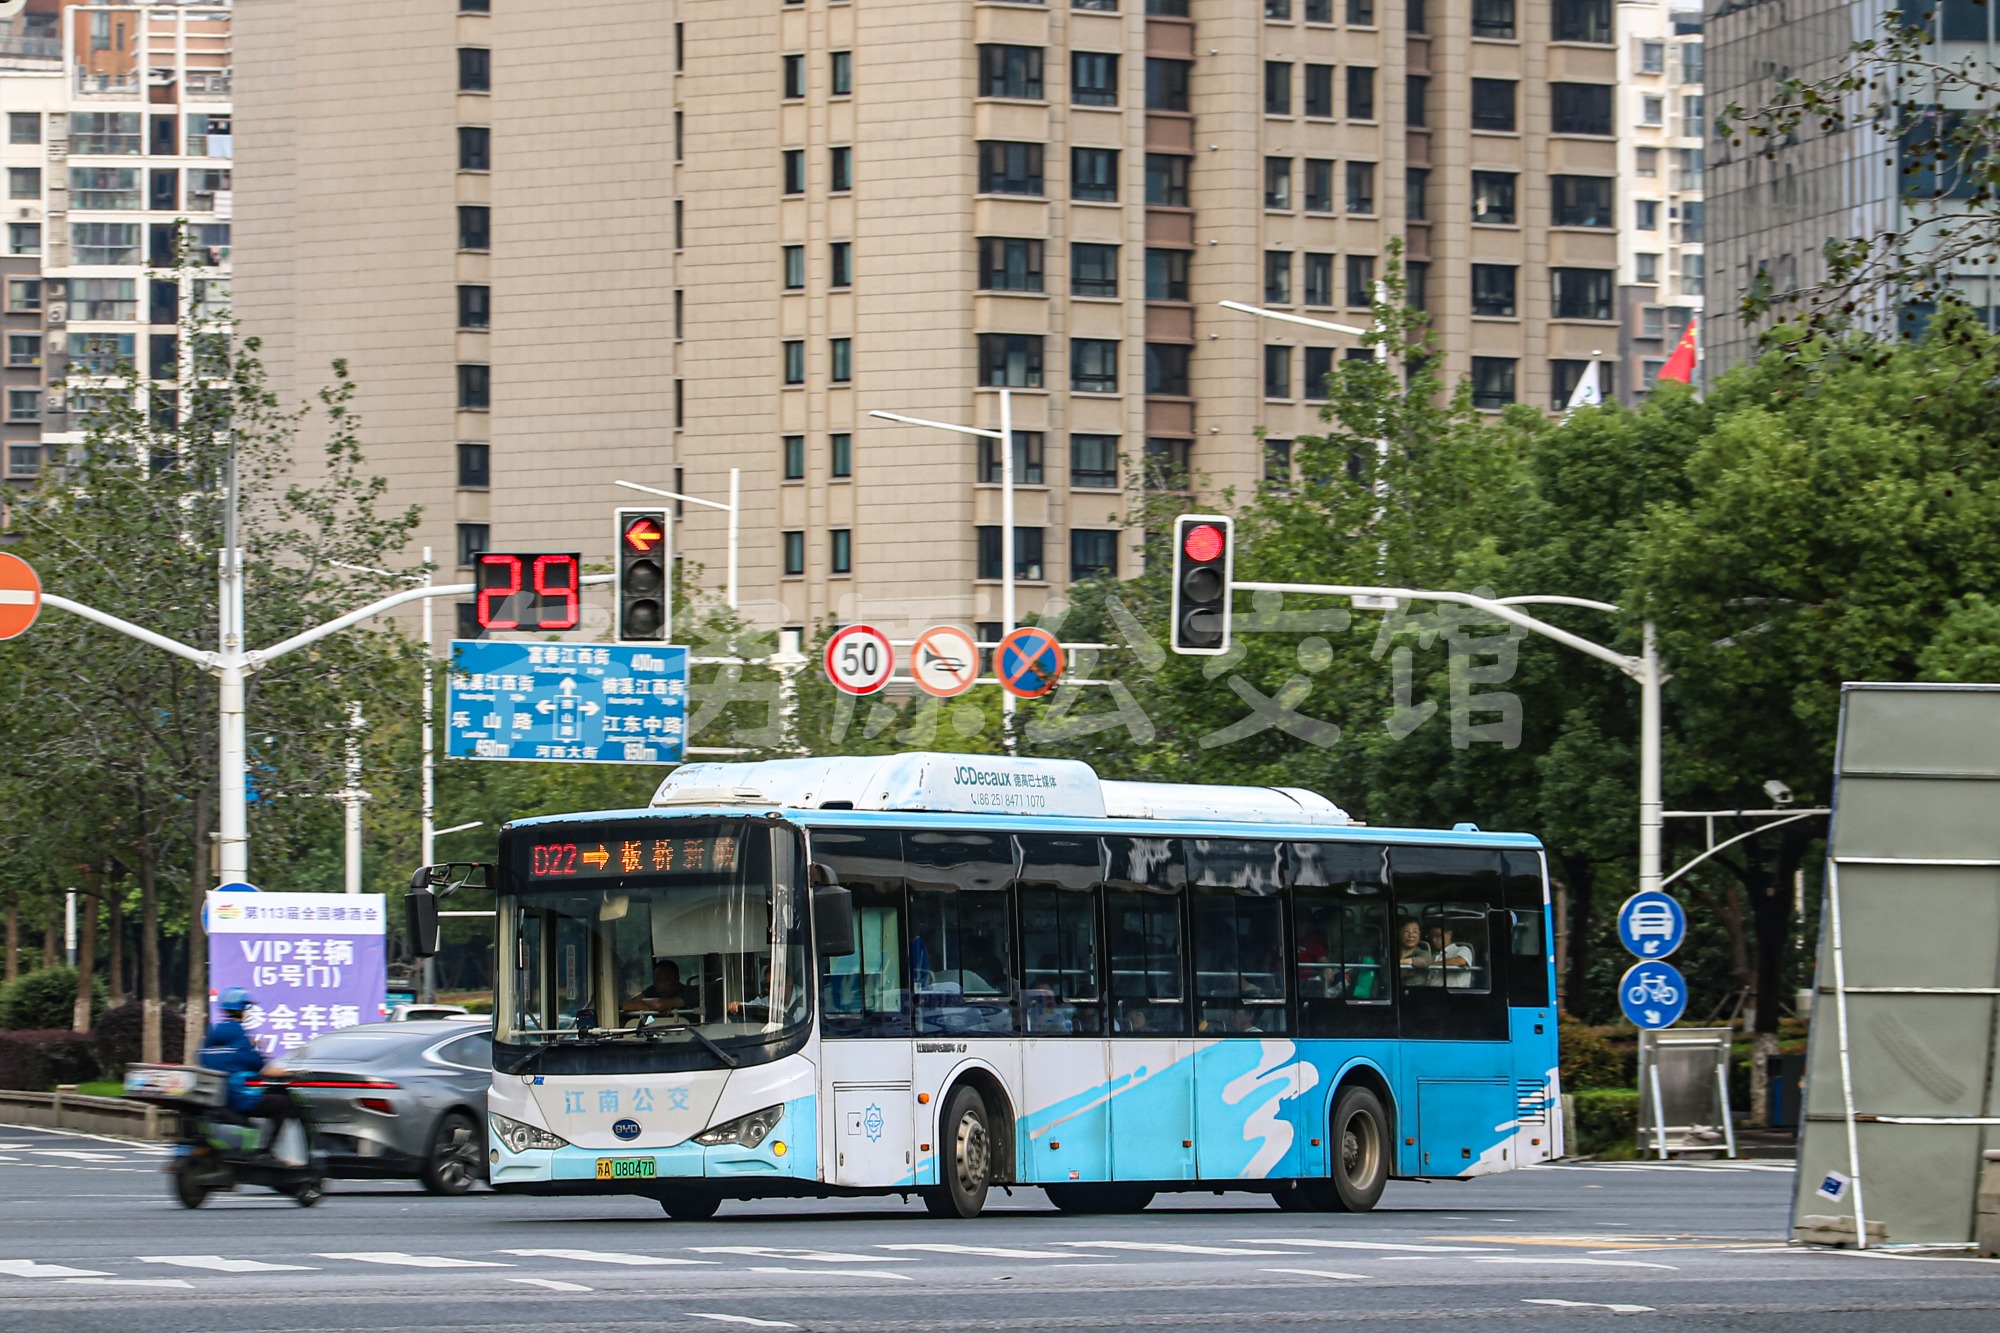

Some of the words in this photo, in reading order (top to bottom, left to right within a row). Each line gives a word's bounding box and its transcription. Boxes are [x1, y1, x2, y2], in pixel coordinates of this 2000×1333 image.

[477, 554, 580, 630] 29
[527, 646, 611, 665] 富春江西街
[841, 642, 878, 676] 50
[602, 715, 684, 734] 江东中路
[535, 745, 599, 759] 河西大街
[953, 766, 1012, 787] JCDecaux
[1014, 773, 1057, 789] 德高巴士媒体
[976, 793, 989, 806] (86
[991, 794, 1004, 806] 25)
[1005, 794, 1023, 807] 8471
[1026, 795, 1046, 808] 1070
[533, 843, 577, 876] D22
[243, 905, 378, 921] 第113届全国糖酒会
[239, 938, 354, 965] VIP车辆
[253, 965, 342, 988] (5号门)
[241, 1003, 360, 1030] 参会车辆
[565, 1087, 690, 1115] 江南公交
[615, 1124, 638, 1134] BYD
